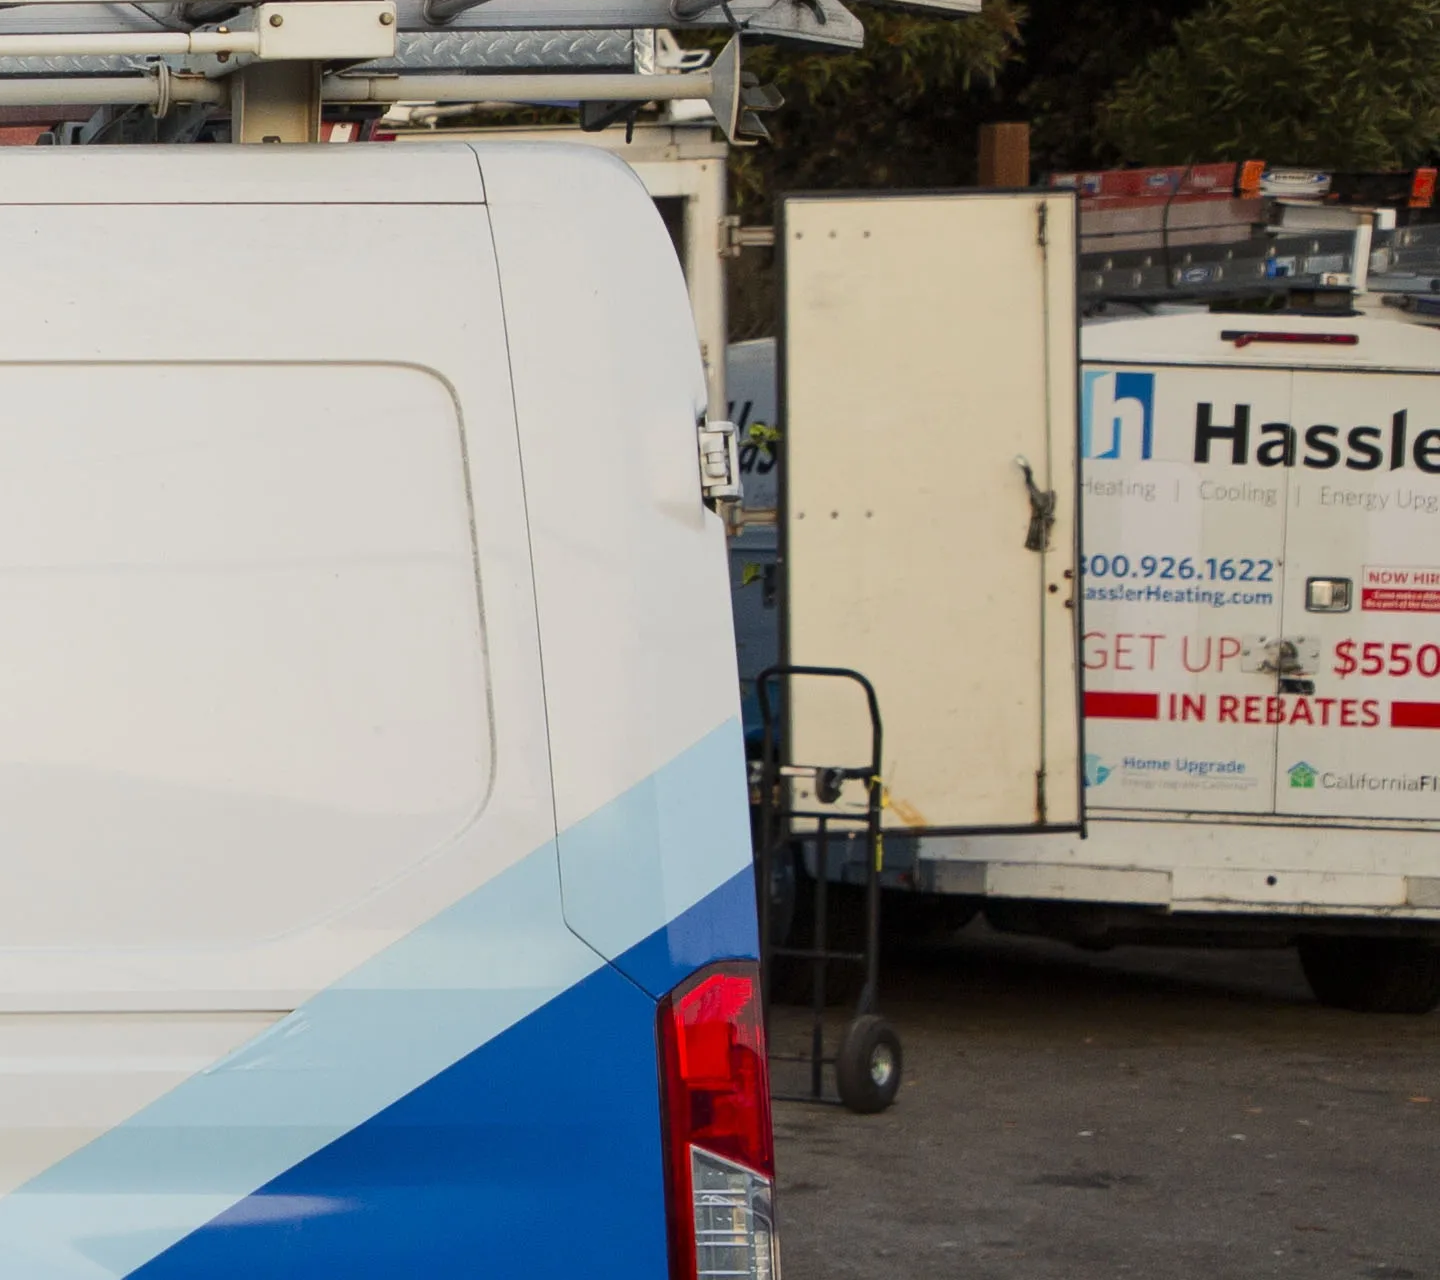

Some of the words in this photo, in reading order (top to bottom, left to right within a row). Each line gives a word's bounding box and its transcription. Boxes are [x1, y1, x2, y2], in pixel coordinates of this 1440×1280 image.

[1199, 480, 1277, 505] Cooling
[1321, 486, 1389, 510] Energy
[1368, 571, 1409, 584] NOW
[1084, 585, 1273, 608] asslerHeating.com
[1081, 631, 1166, 671] GET
[1182, 635, 1241, 673] UP
[1169, 693, 1206, 722] IN
[1218, 694, 1380, 728] REBATES
[1123, 757, 1171, 771] Home
[1176, 758, 1246, 776] Upgrade
